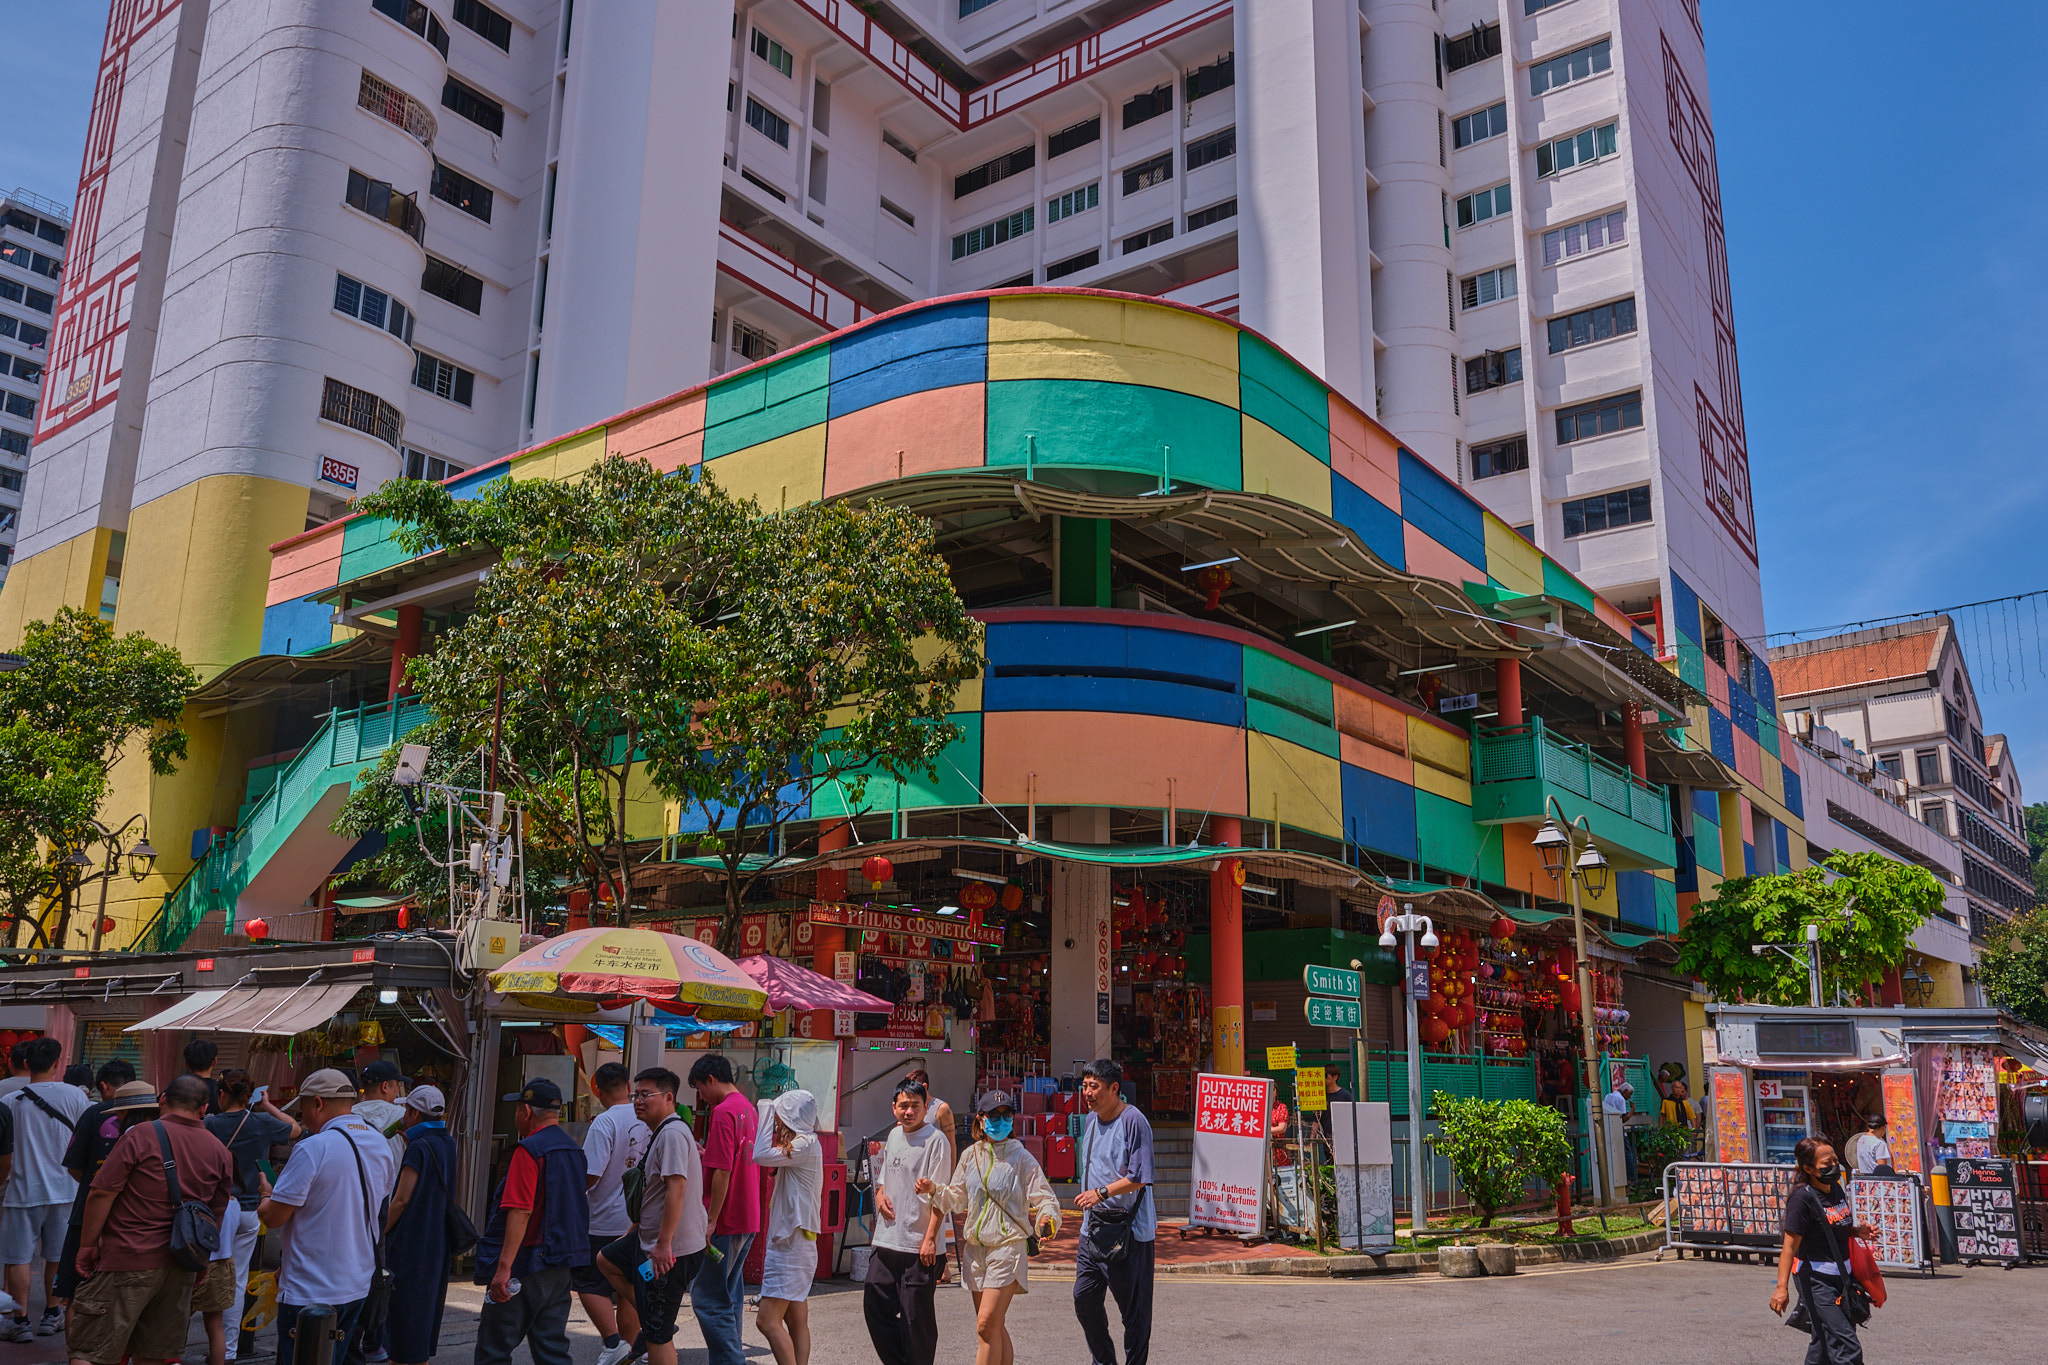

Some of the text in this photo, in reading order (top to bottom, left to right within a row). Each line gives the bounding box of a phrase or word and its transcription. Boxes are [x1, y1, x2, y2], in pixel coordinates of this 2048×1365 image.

[66, 374, 92, 401] 335B
[323, 460, 357, 485] 335B
[813, 912, 841, 923] PERFUME
[847, 908, 974, 941] PHILMS COSMETIC
[593, 959, 661, 971] 牛车水夜市
[1312, 970, 1357, 993] Smith St
[1312, 1003, 1357, 1024] 史密斯街
[869, 1040, 932, 1049] DUTY-FREE PERFUMES
[1201, 1080, 1264, 1099] DUTY-FREE
[1759, 1081, 1778, 1098] $1
[1203, 1094, 1260, 1113] PERFUME
[347, 1123, 369, 1131] CHINA
[1199, 1110, 1261, 1134] 免税香水
[1972, 1168, 1996, 1176] Henna
[1198, 1180, 1257, 1196] 100% Authentic
[1195, 1189, 1258, 1207] Original Perfume
[1194, 1204, 1257, 1220] No. Pagoda Street
[1970, 1189, 1990, 1256] HENNA
[1982, 1190, 2000, 1256] TATTOO
